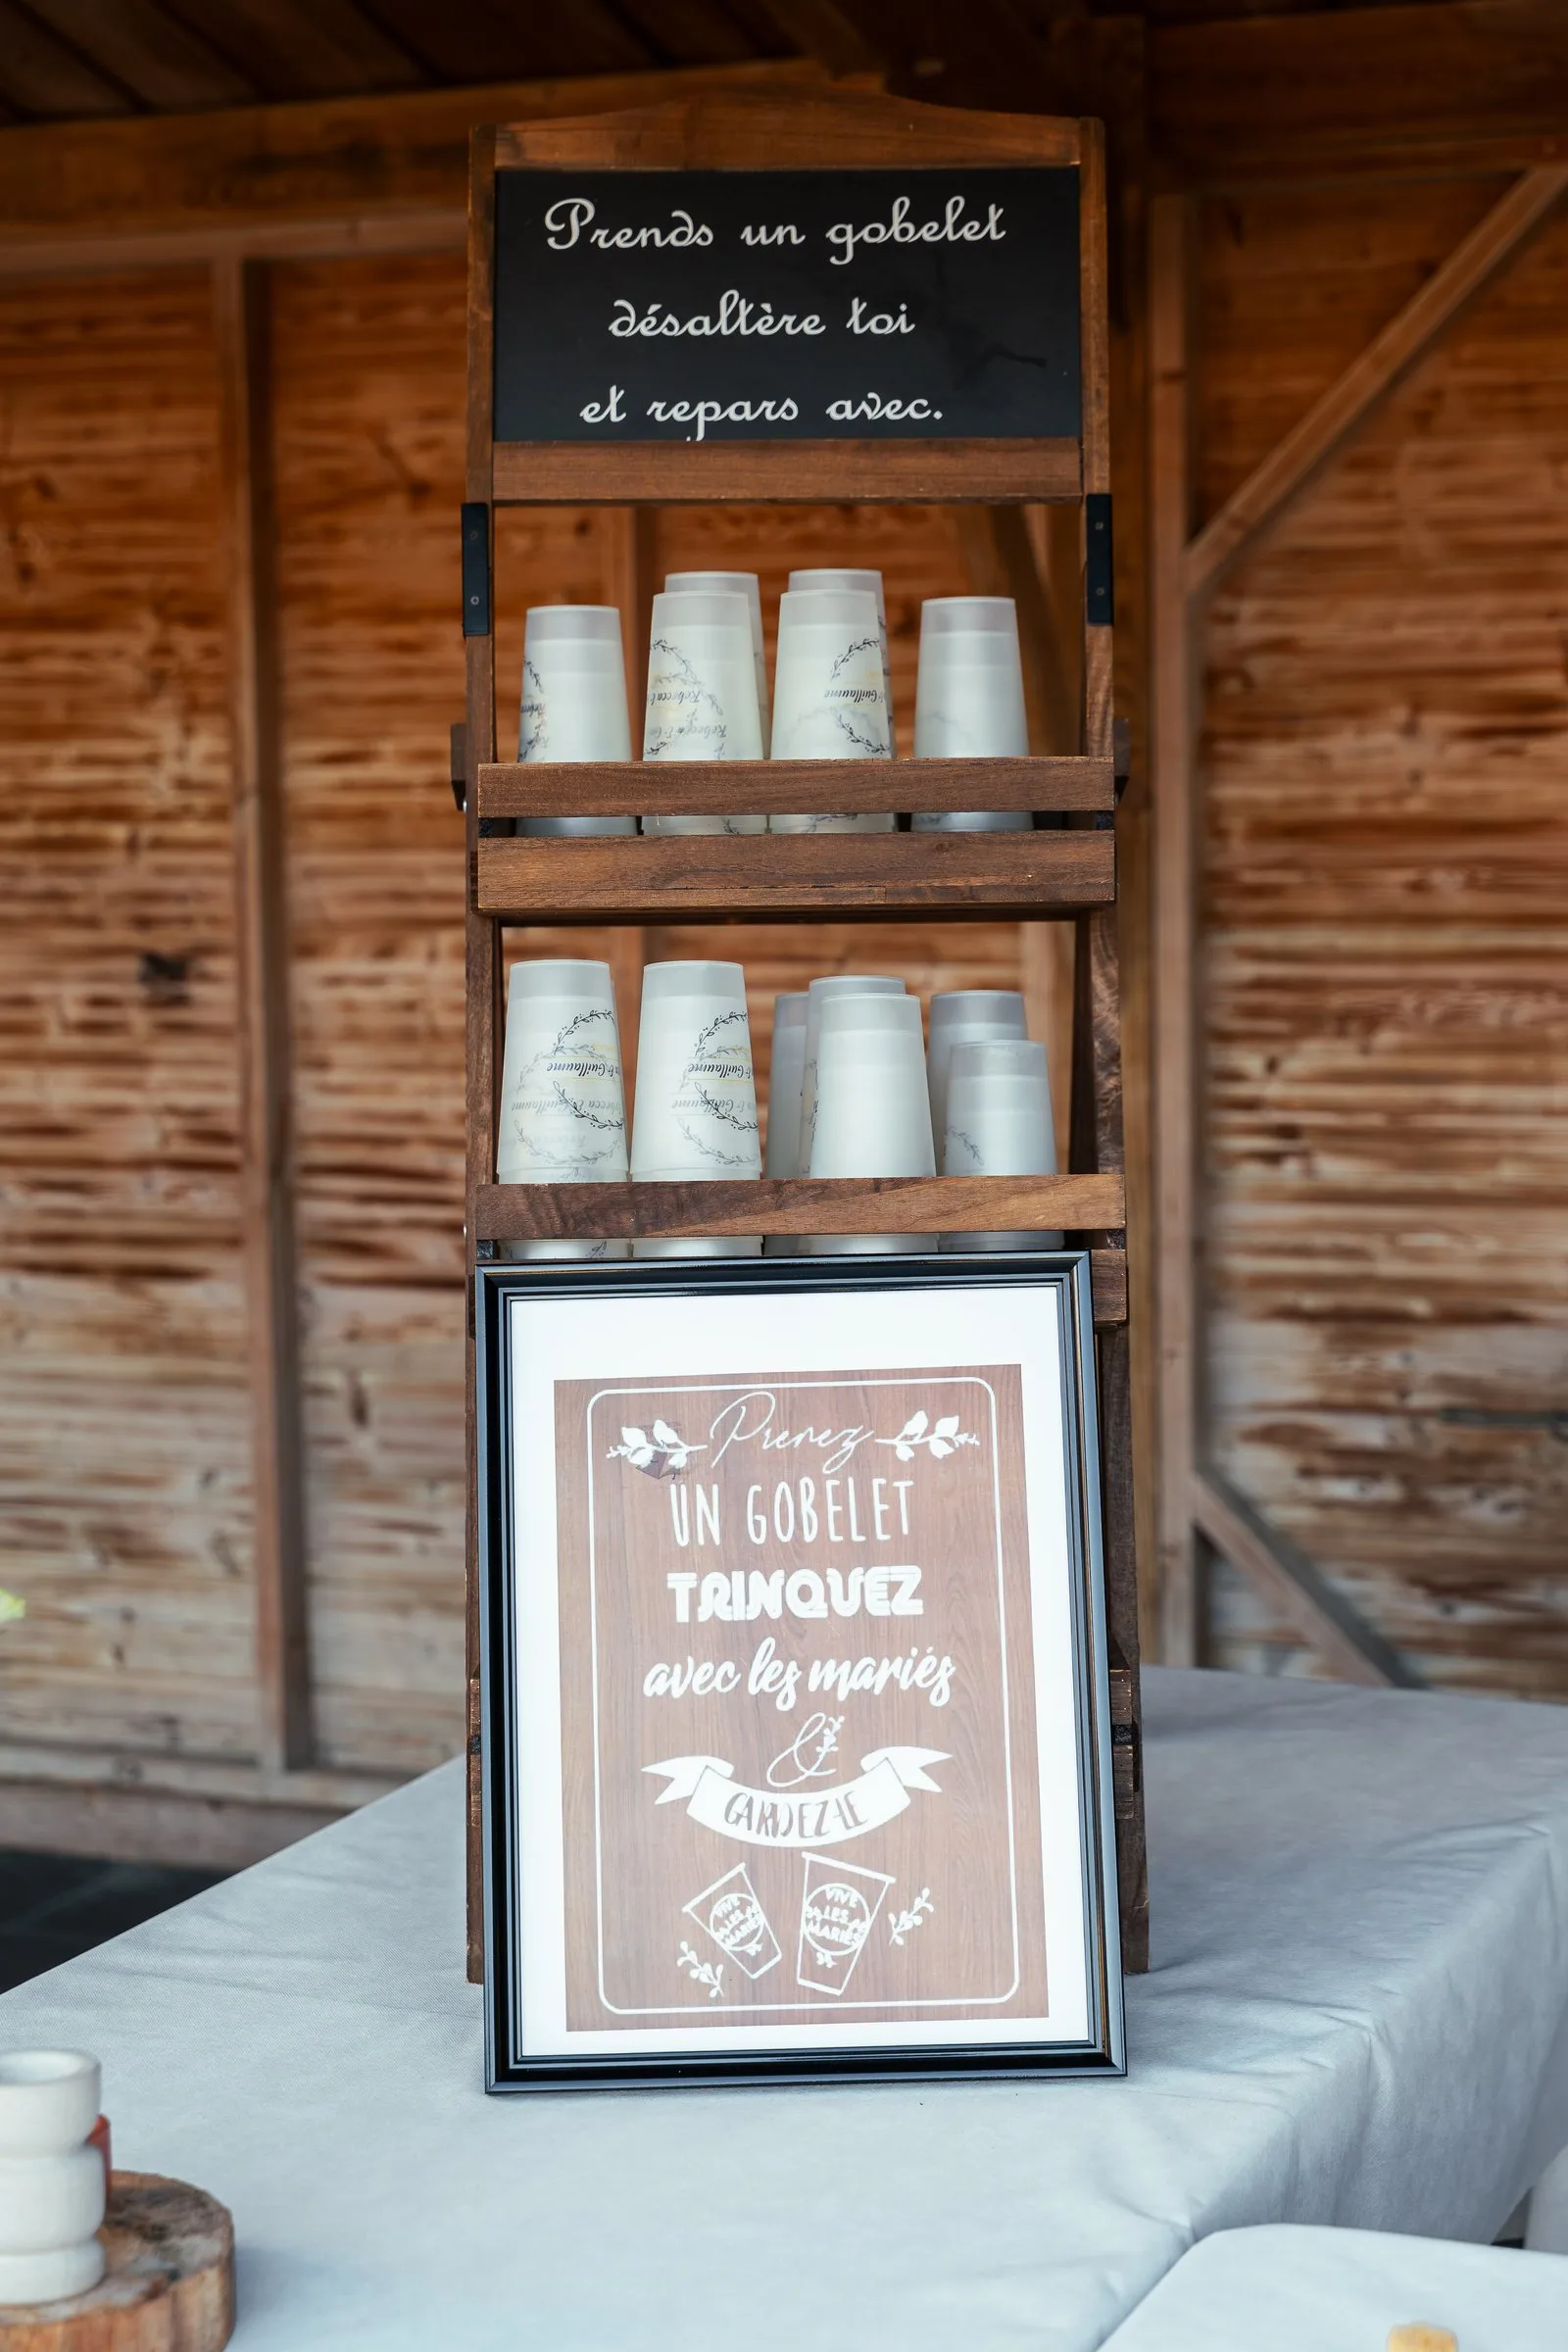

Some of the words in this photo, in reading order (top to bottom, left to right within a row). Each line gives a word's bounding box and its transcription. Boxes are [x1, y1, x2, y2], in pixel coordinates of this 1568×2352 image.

[544, 197, 714, 250] Prends
[740, 222, 807, 247] un
[824, 195, 1006, 266] gobelet
[608, 289, 826, 338] désaltère
[846, 297, 915, 336] toi
[579, 385, 627, 424] et
[646, 394, 799, 441] repars
[825, 392, 944, 421] avec.
[546, 1062, 606, 1077] Guillaume
[686, 1063, 744, 1079] Guillaume
[710, 1391, 875, 1474] Prenez
[669, 1482, 720, 1546] UN
[746, 1476, 914, 1545] GOBELET
[666, 1565, 924, 1623] TRINQUEZ
[643, 1656, 741, 1698] avec
[748, 1637, 802, 1712] les
[808, 1646, 956, 1707] mariés
[765, 1712, 845, 1788] &
[824, 1904, 850, 1923] LES
[825, 1886, 860, 1908] VIVE
